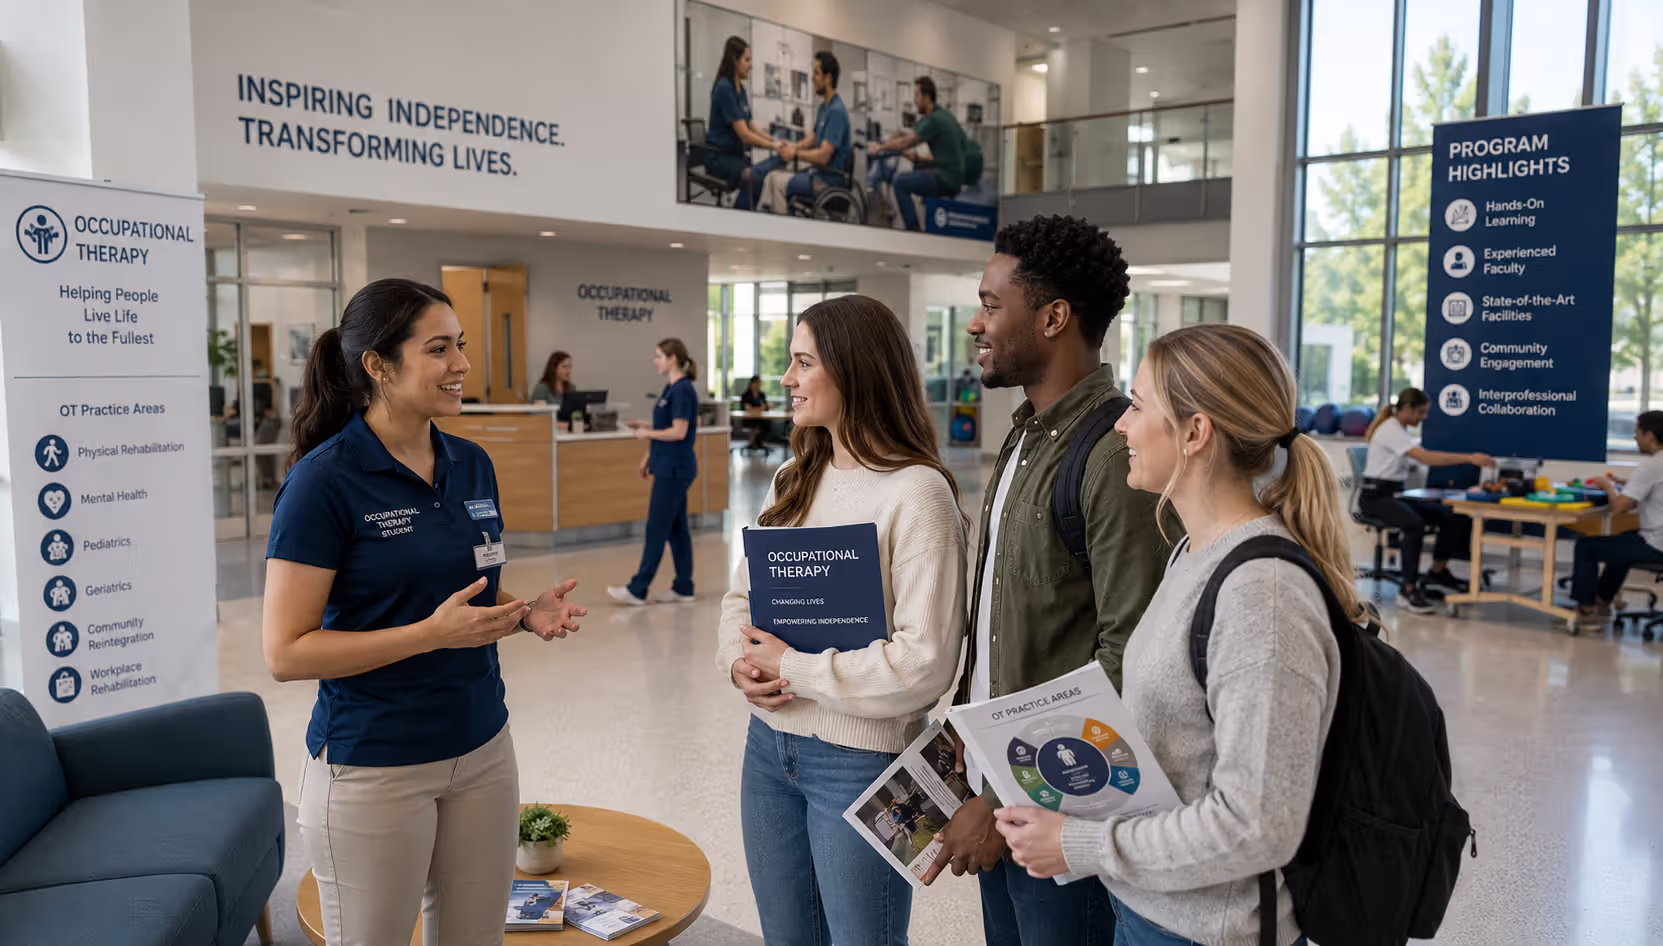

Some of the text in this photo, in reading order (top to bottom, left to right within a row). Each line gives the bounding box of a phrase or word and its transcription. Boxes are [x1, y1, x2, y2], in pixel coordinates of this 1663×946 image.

[237, 73, 566, 147] INSPIRING INDEPENDENCE.
[238, 116, 518, 176] TRANSFORMING LIVES.
[1449, 134, 1549, 159] PROGRAM
[1448, 156, 1571, 183] HIGHLIGHTS
[1485, 198, 1545, 212] Hands-On
[74, 215, 194, 243] OCCUPATIONAL
[1485, 214, 1536, 228] Learning
[76, 243, 149, 265] THERAPY
[1484, 245, 1556, 261] Experienced
[1483, 262, 1526, 276] Faculty
[59, 285, 159, 305] Helping People
[577, 284, 672, 303] OCCUPATIONAL
[1482, 294, 1576, 308] State-of-the-Art
[84, 308, 138, 324] Live Life
[597, 306, 654, 323] THERAPY
[1481, 310, 1533, 323] Facilities
[68, 331, 155, 345] to the Fullest
[1480, 342, 1549, 357] Community
[1480, 357, 1555, 371] Engagement
[1478, 388, 1578, 404] Interprofessional
[59, 402, 166, 417] OT Practice Areas
[1478, 403, 1557, 418] Collaboration
[78, 442, 185, 460] Physical Rehabilitation
[80, 489, 148, 505] Mental Health
[364, 508, 420, 522] OCCUPATIONAL
[381, 526, 414, 537] STUDENT
[83, 537, 131, 551] Pediatrics
[768, 550, 859, 562] OCCUPATIONAL
[769, 565, 831, 578] THERAPY
[85, 581, 132, 596] Geriatrics
[87, 617, 144, 635] Community
[818, 616, 869, 625] INDEPENDENCE
[88, 630, 155, 650] Reintegration
[90, 662, 142, 680] Workplace
[90, 675, 156, 696] Rehabilitation
[991, 687, 1082, 721] OT PRACTICE AREAS
